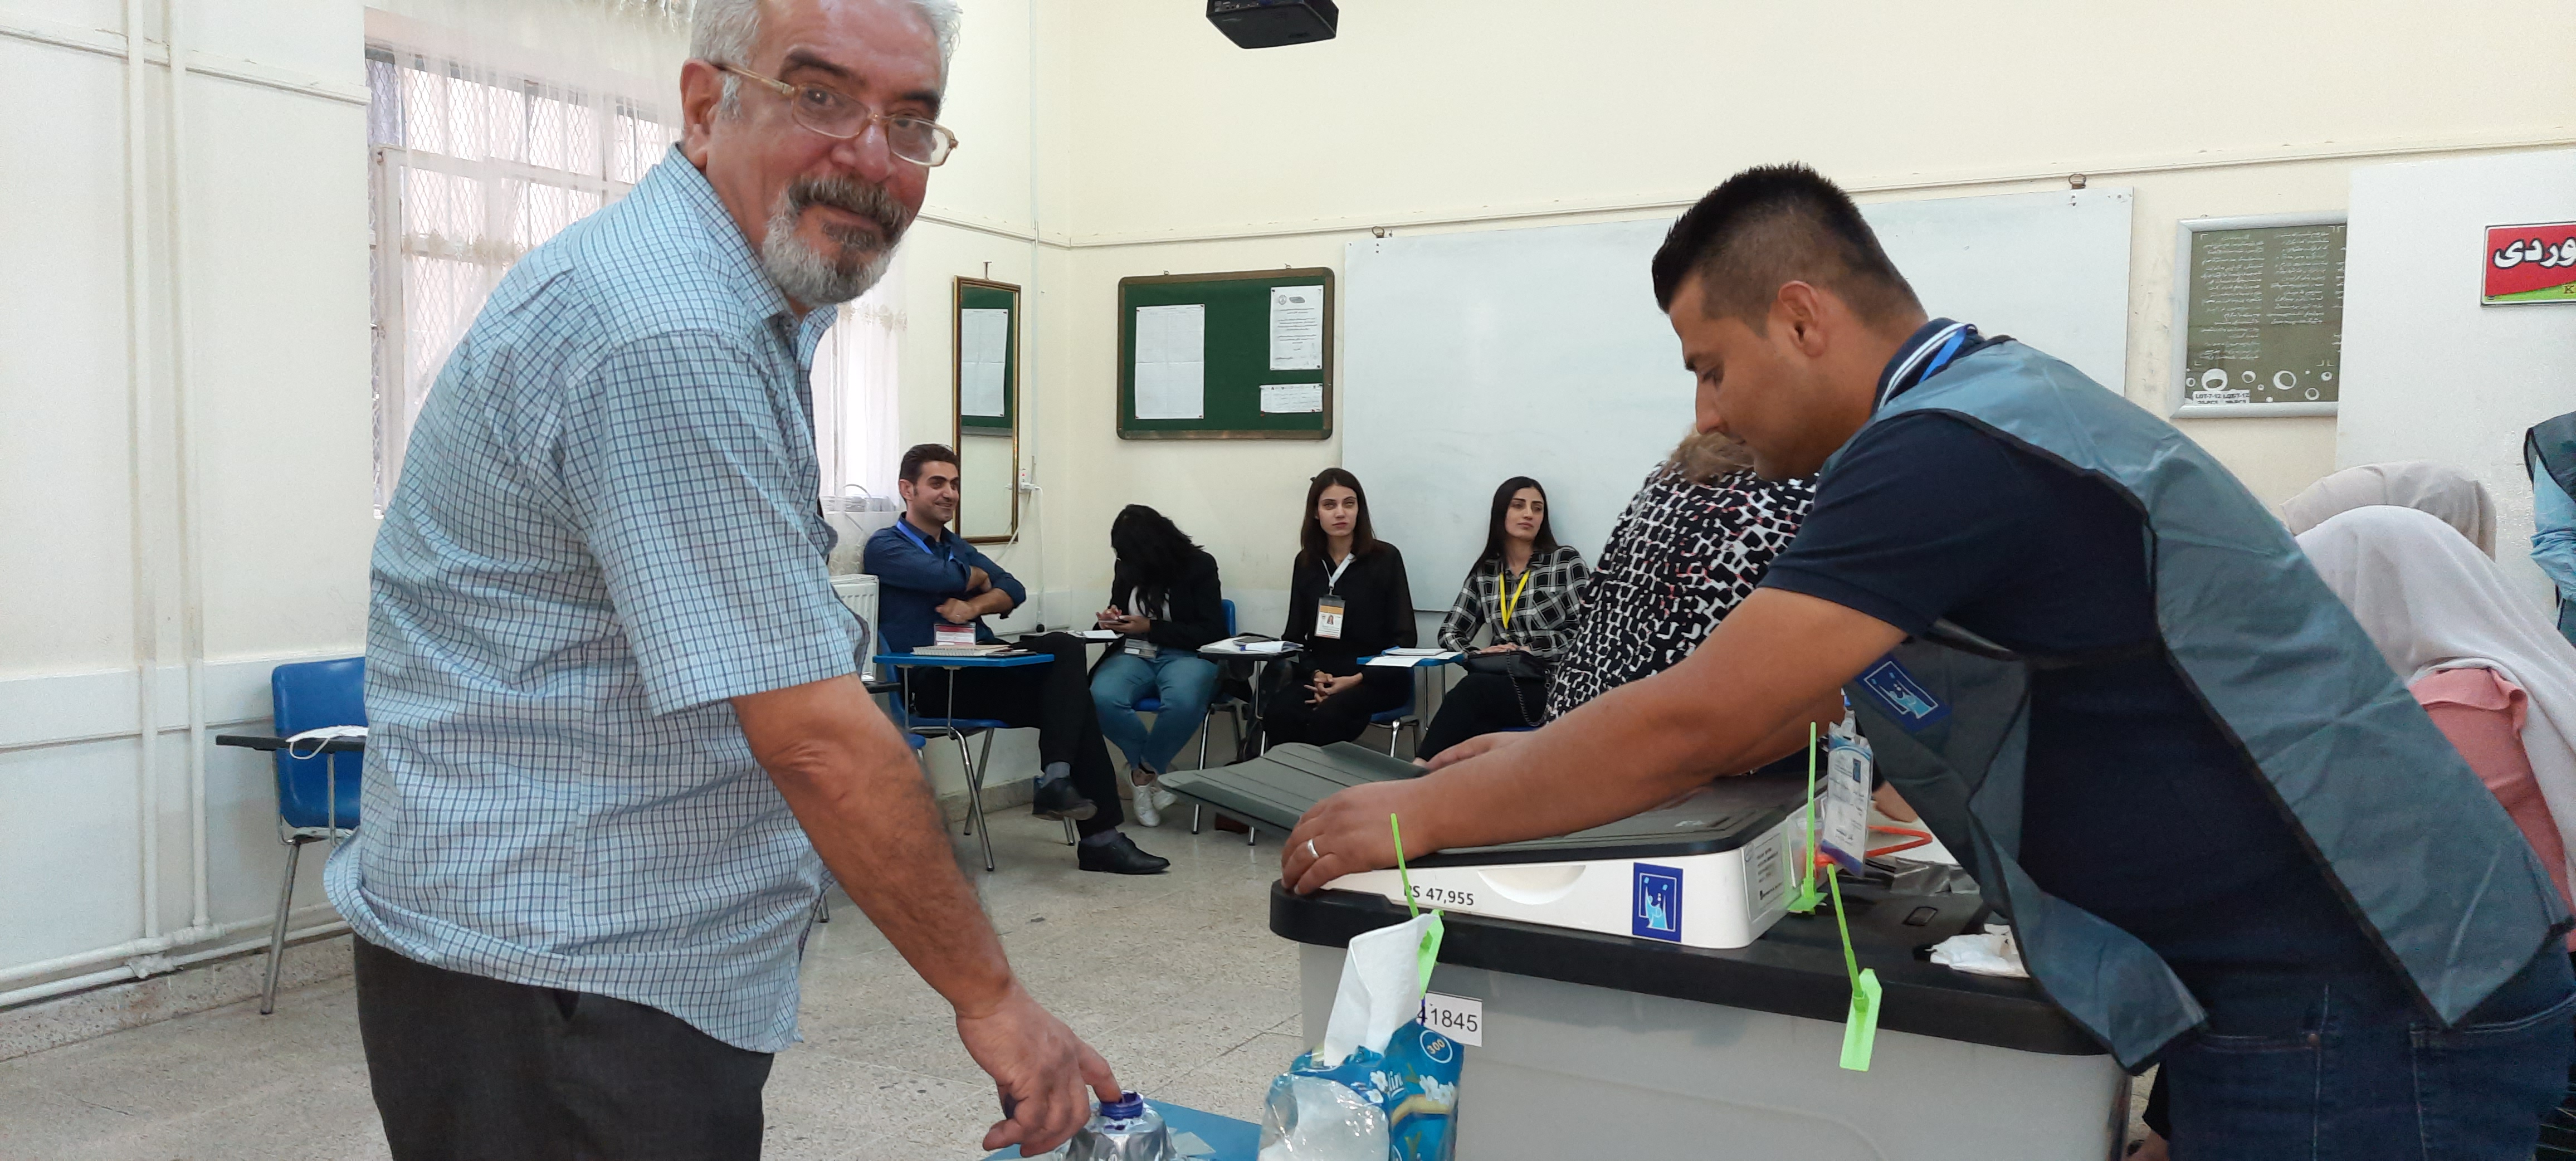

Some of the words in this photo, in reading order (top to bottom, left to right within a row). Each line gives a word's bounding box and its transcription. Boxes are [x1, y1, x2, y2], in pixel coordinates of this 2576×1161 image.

[2563, 285, 2576, 294] K
[1426, 887, 1474, 906] 47,955
[1417, 1005, 1478, 1032] 41845
[1427, 1038, 1446, 1055] 300
